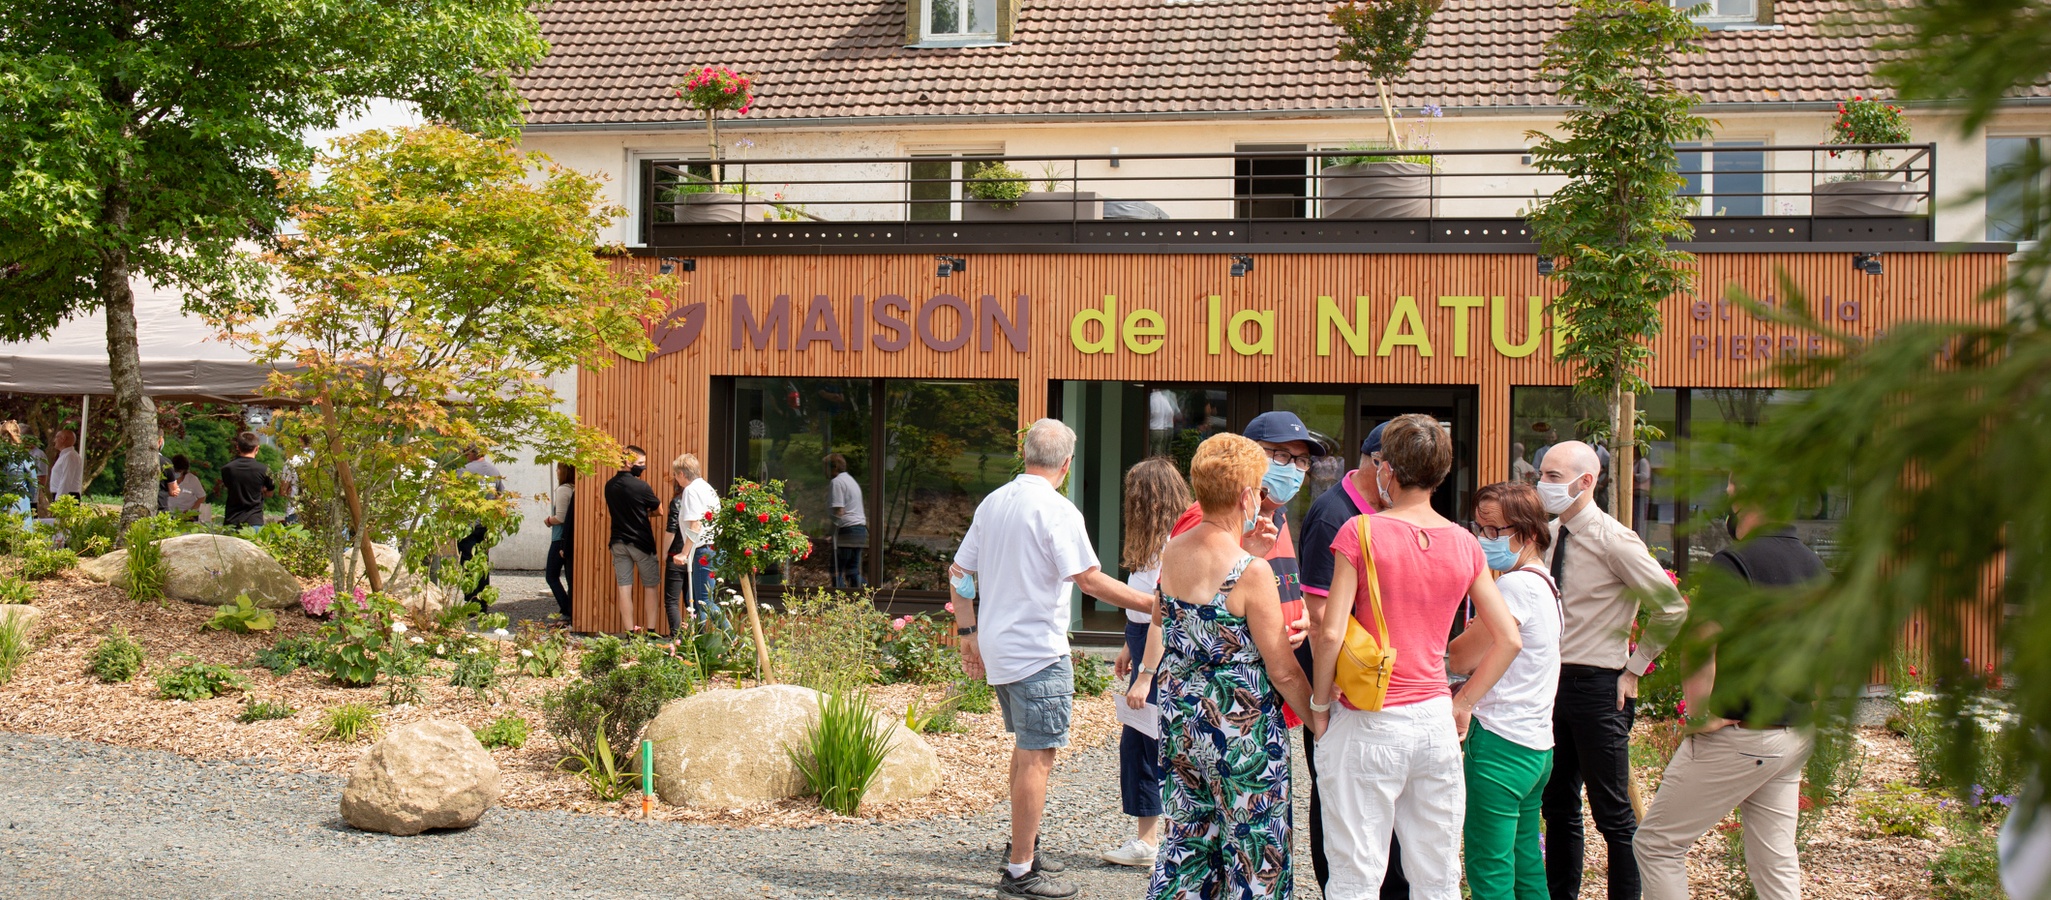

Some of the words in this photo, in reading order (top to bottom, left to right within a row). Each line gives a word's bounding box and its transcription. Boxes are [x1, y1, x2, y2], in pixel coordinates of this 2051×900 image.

[1692, 297, 1730, 321] et
[1823, 295, 1860, 321] la
[731, 294, 1029, 353] MAISON
[1071, 295, 1166, 355] de
[1208, 295, 1275, 355] la
[1316, 295, 1648, 358] NATU
[1690, 335, 1823, 360] PIERRE
